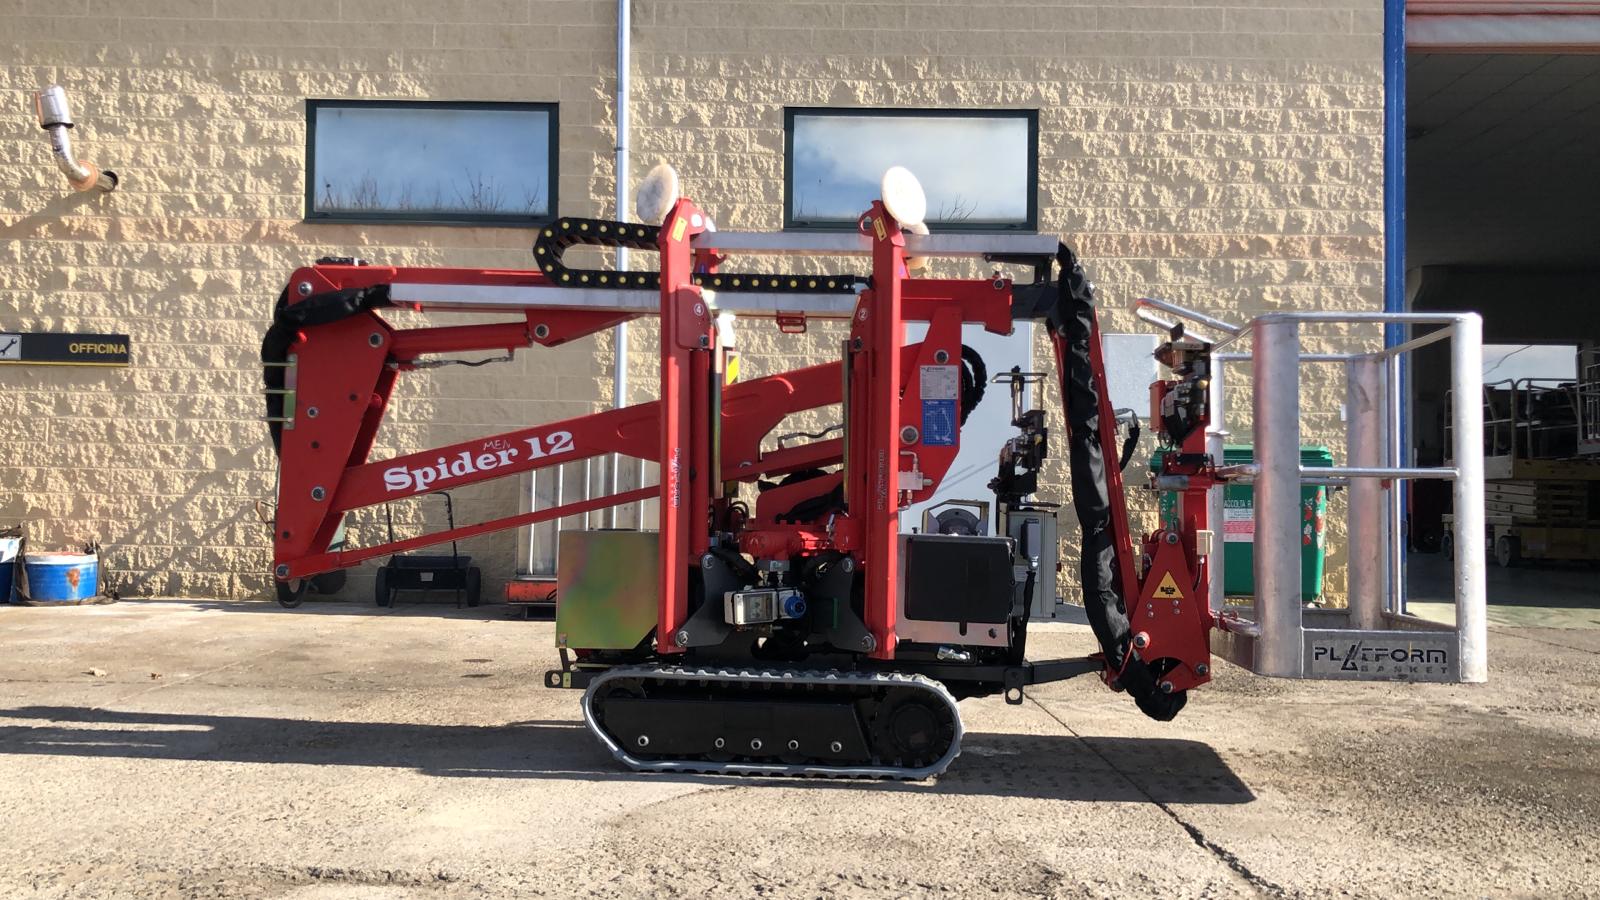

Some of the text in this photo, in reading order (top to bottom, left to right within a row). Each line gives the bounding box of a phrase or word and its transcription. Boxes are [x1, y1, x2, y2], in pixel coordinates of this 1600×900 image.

[69, 343, 127, 354] OFFICINA
[383, 431, 575, 492] Spider 12
[1224, 499, 1246, 508] ACCOLTA
[1314, 640, 1447, 671] PLATFORM
[1361, 666, 1448, 674] BASKET
